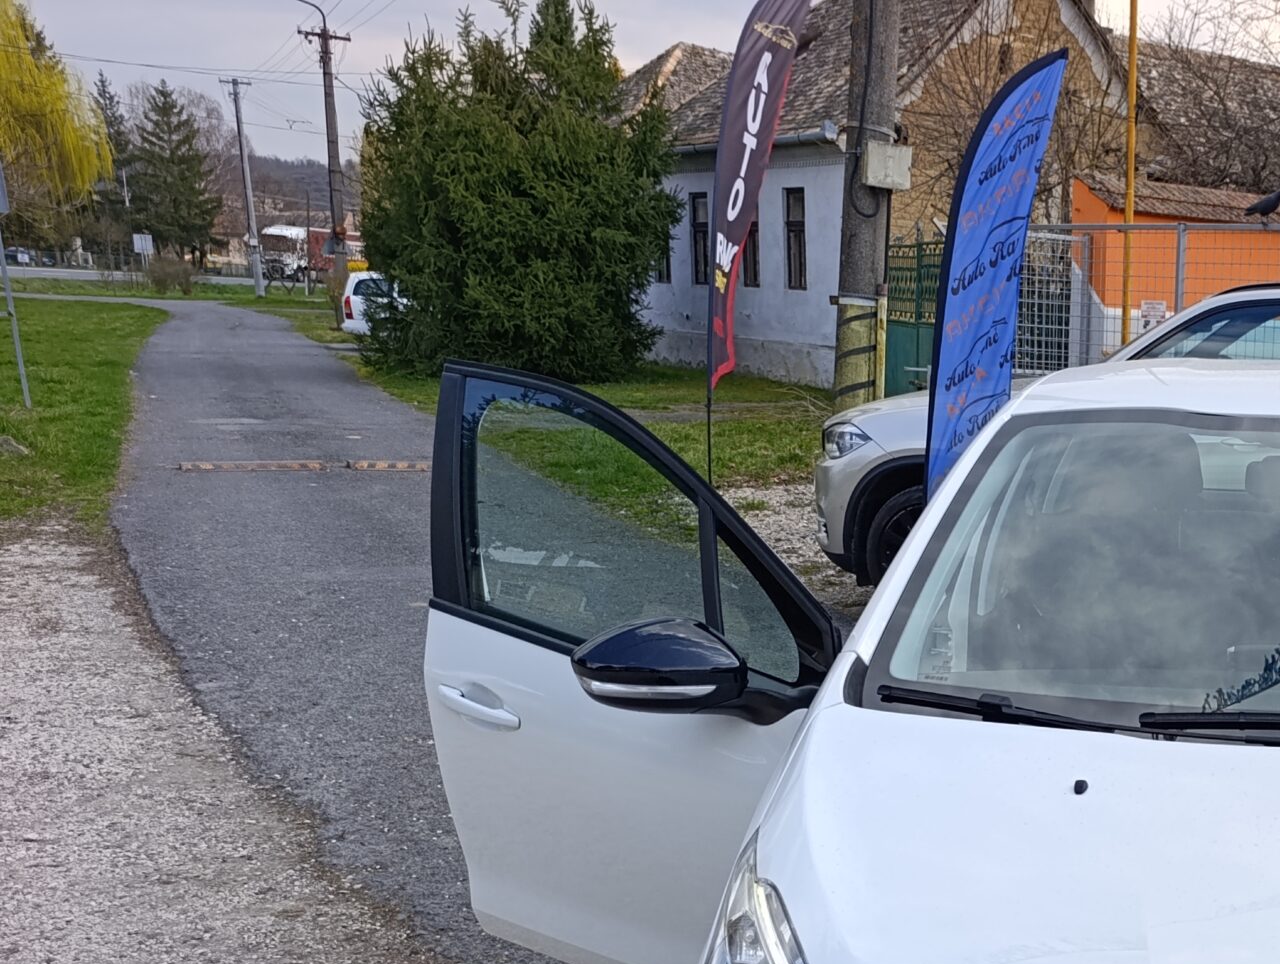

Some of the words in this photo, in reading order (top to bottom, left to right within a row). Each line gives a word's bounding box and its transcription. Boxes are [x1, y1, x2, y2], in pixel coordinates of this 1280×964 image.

[728, 51, 772, 221] AUTO
[951, 256, 986, 296] Auto
[989, 238, 1020, 268] Ra
[945, 359, 976, 392] Auto
